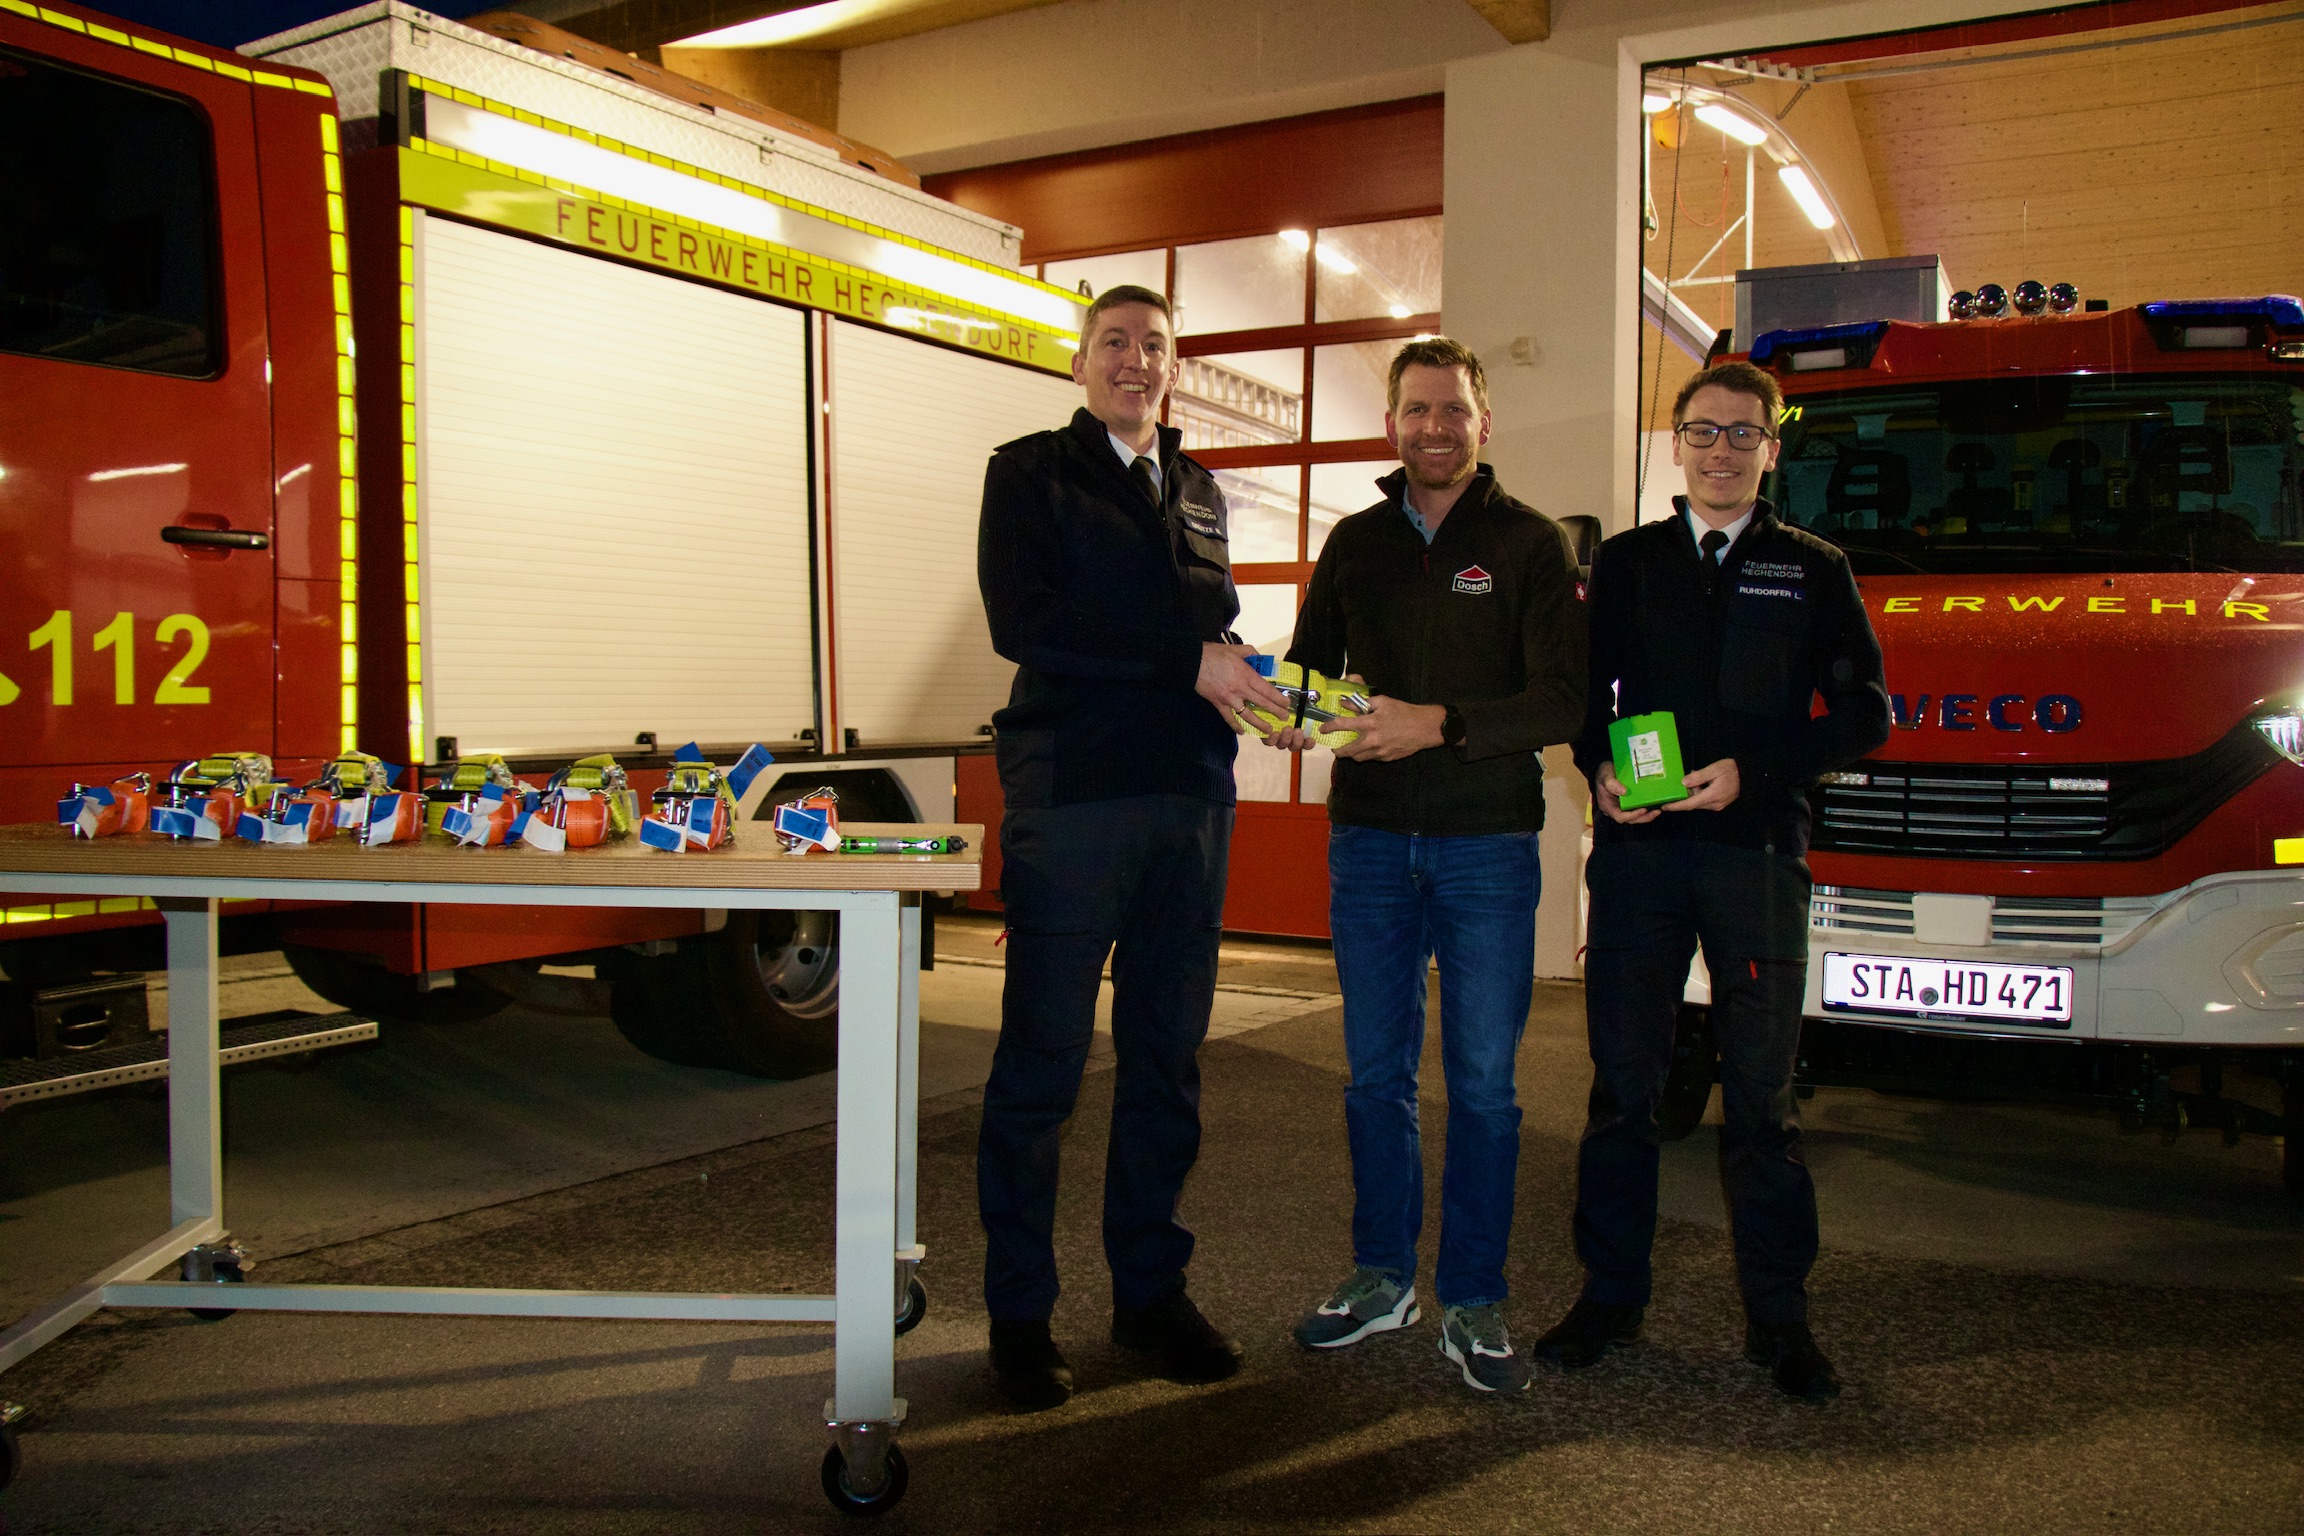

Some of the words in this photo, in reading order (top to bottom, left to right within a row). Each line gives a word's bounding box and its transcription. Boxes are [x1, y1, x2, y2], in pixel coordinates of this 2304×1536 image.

[557, 197, 813, 301] FEUERWEHR
[1741, 567, 1805, 579] HECHENDORF
[1745, 560, 1802, 571] FEUERWEHR
[1457, 580, 1488, 591] Dosch
[1739, 586, 1792, 598] RUHDORFER
[1882, 595, 2271, 622] ERWEHR
[28, 609, 212, 706] 112
[1887, 693, 2084, 734] VECO
[1850, 963, 1915, 1001] STA
[1943, 969, 1988, 1007] HD
[1997, 973, 2064, 1012] 471
